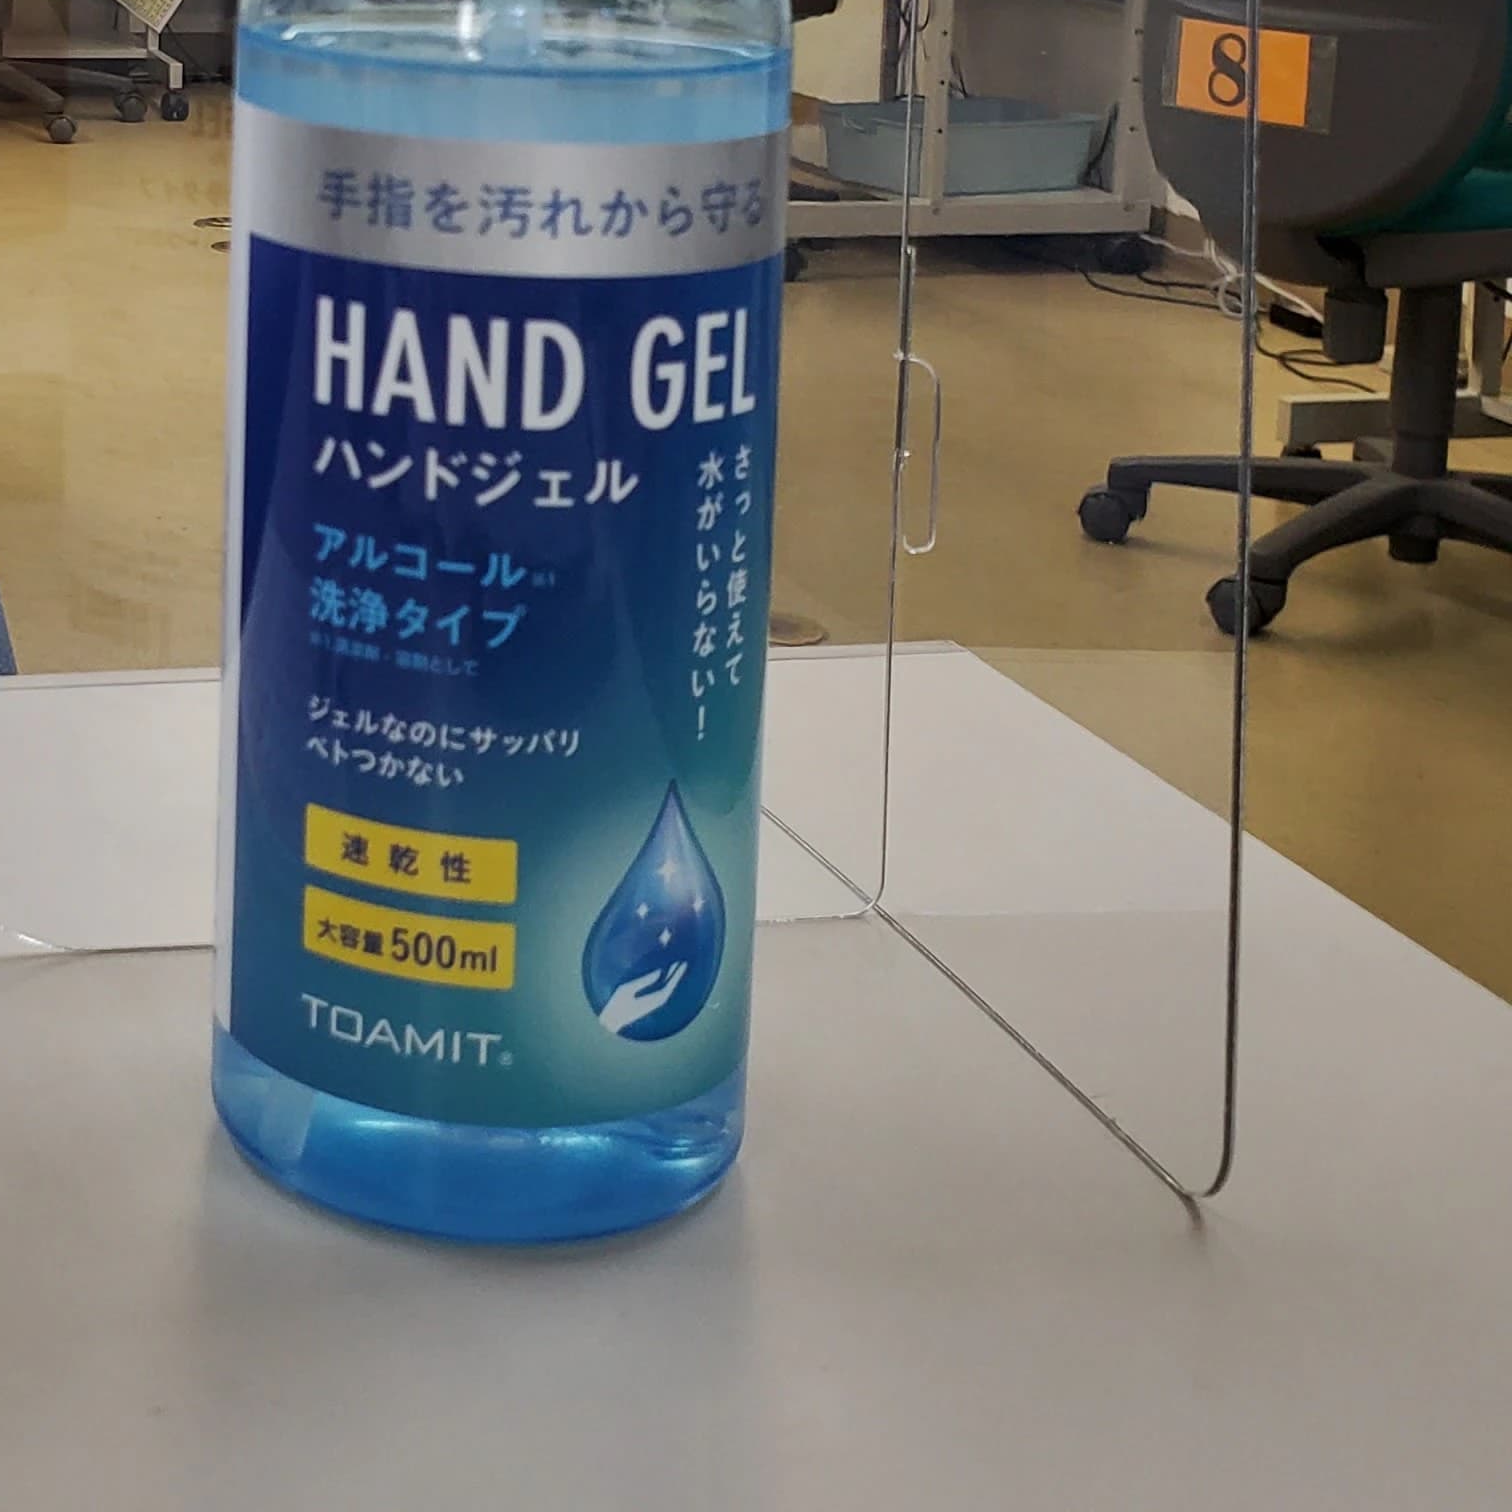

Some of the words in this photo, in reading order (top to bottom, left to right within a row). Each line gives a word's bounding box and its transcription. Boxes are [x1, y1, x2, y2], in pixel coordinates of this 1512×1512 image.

[1208, 33, 1248, 107] 8
[315, 169, 766, 239] 手指を汚れから守る
[313, 295, 586, 431] HAND
[630, 307, 757, 431] GEL
[313, 438, 639, 508] ハンドジェル
[725, 444, 753, 687] さっと使えて
[309, 577, 527, 650] 洗浄タイプ
[307, 694, 579, 758] ジェルなのにサッパリ
[306, 736, 464, 787] ベトつかない
[340, 832, 472, 884] 速乾性
